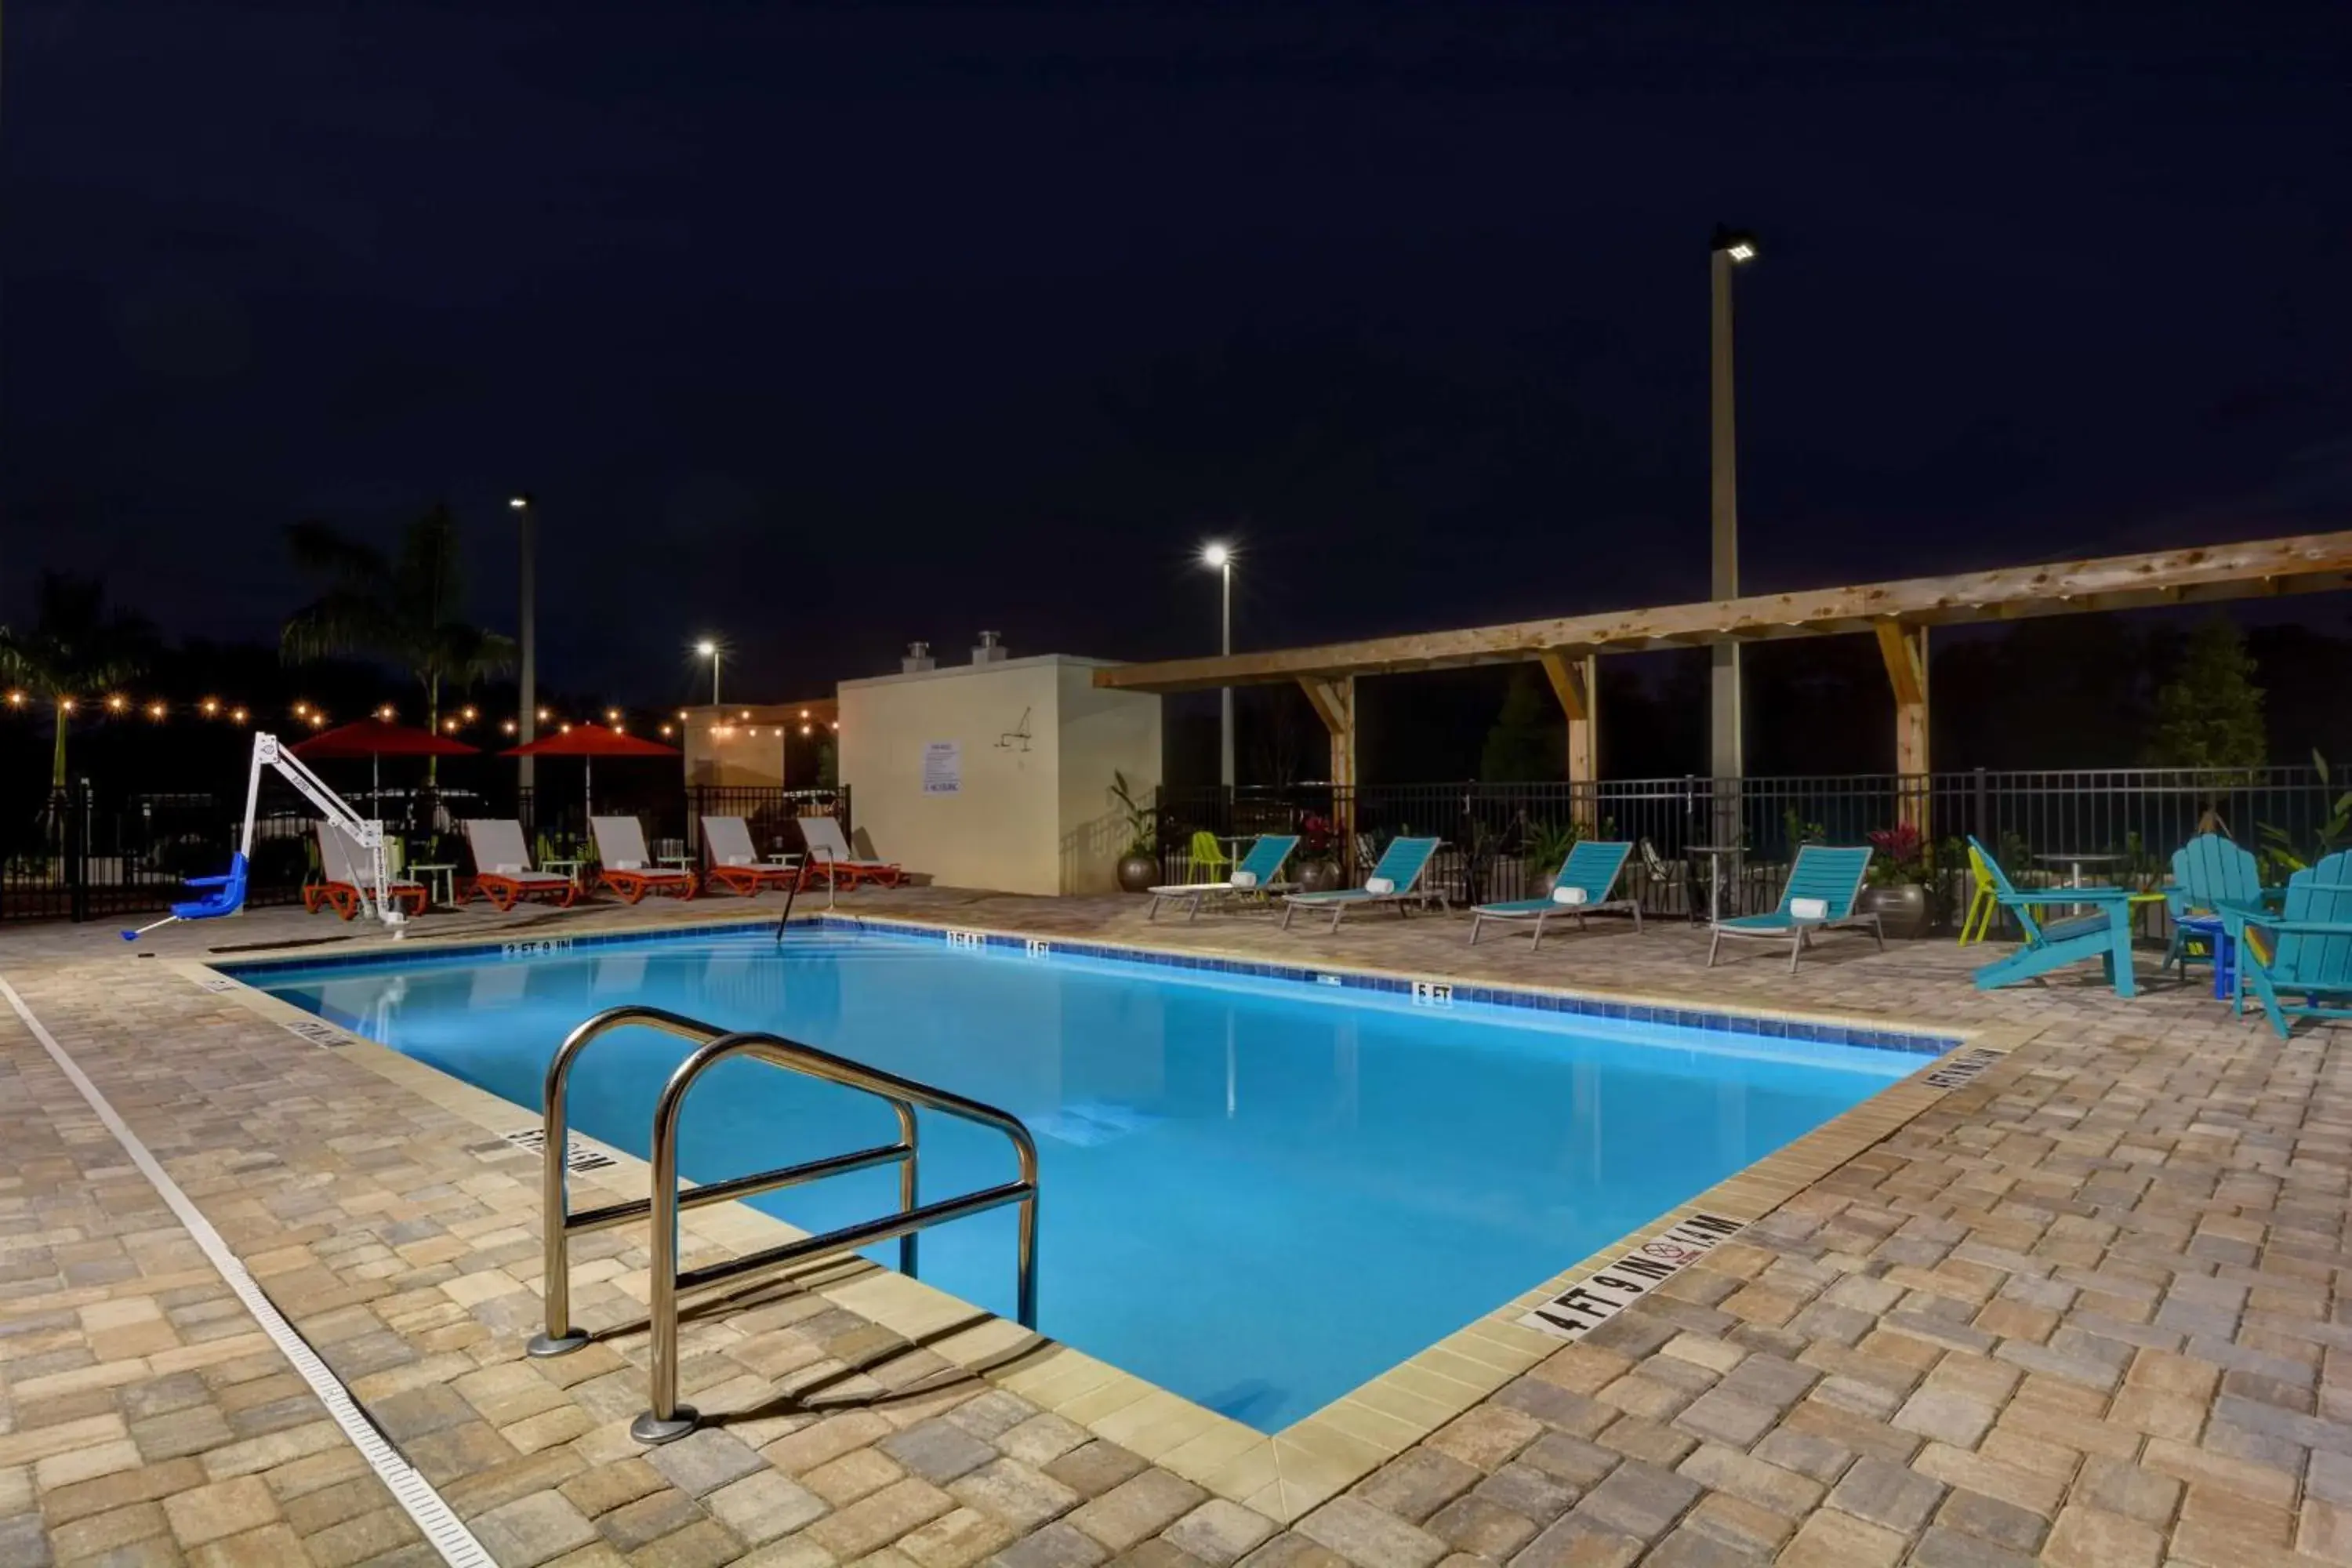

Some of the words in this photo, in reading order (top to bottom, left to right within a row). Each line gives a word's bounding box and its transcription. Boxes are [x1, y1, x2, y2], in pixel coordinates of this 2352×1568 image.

[1685, 1214, 1745, 1235] M
[1611, 1255, 1677, 1280] IN
[1592, 1275, 1644, 1293] 9
[1552, 1288, 1622, 1318] FT
[1534, 1310, 1589, 1330] 4
